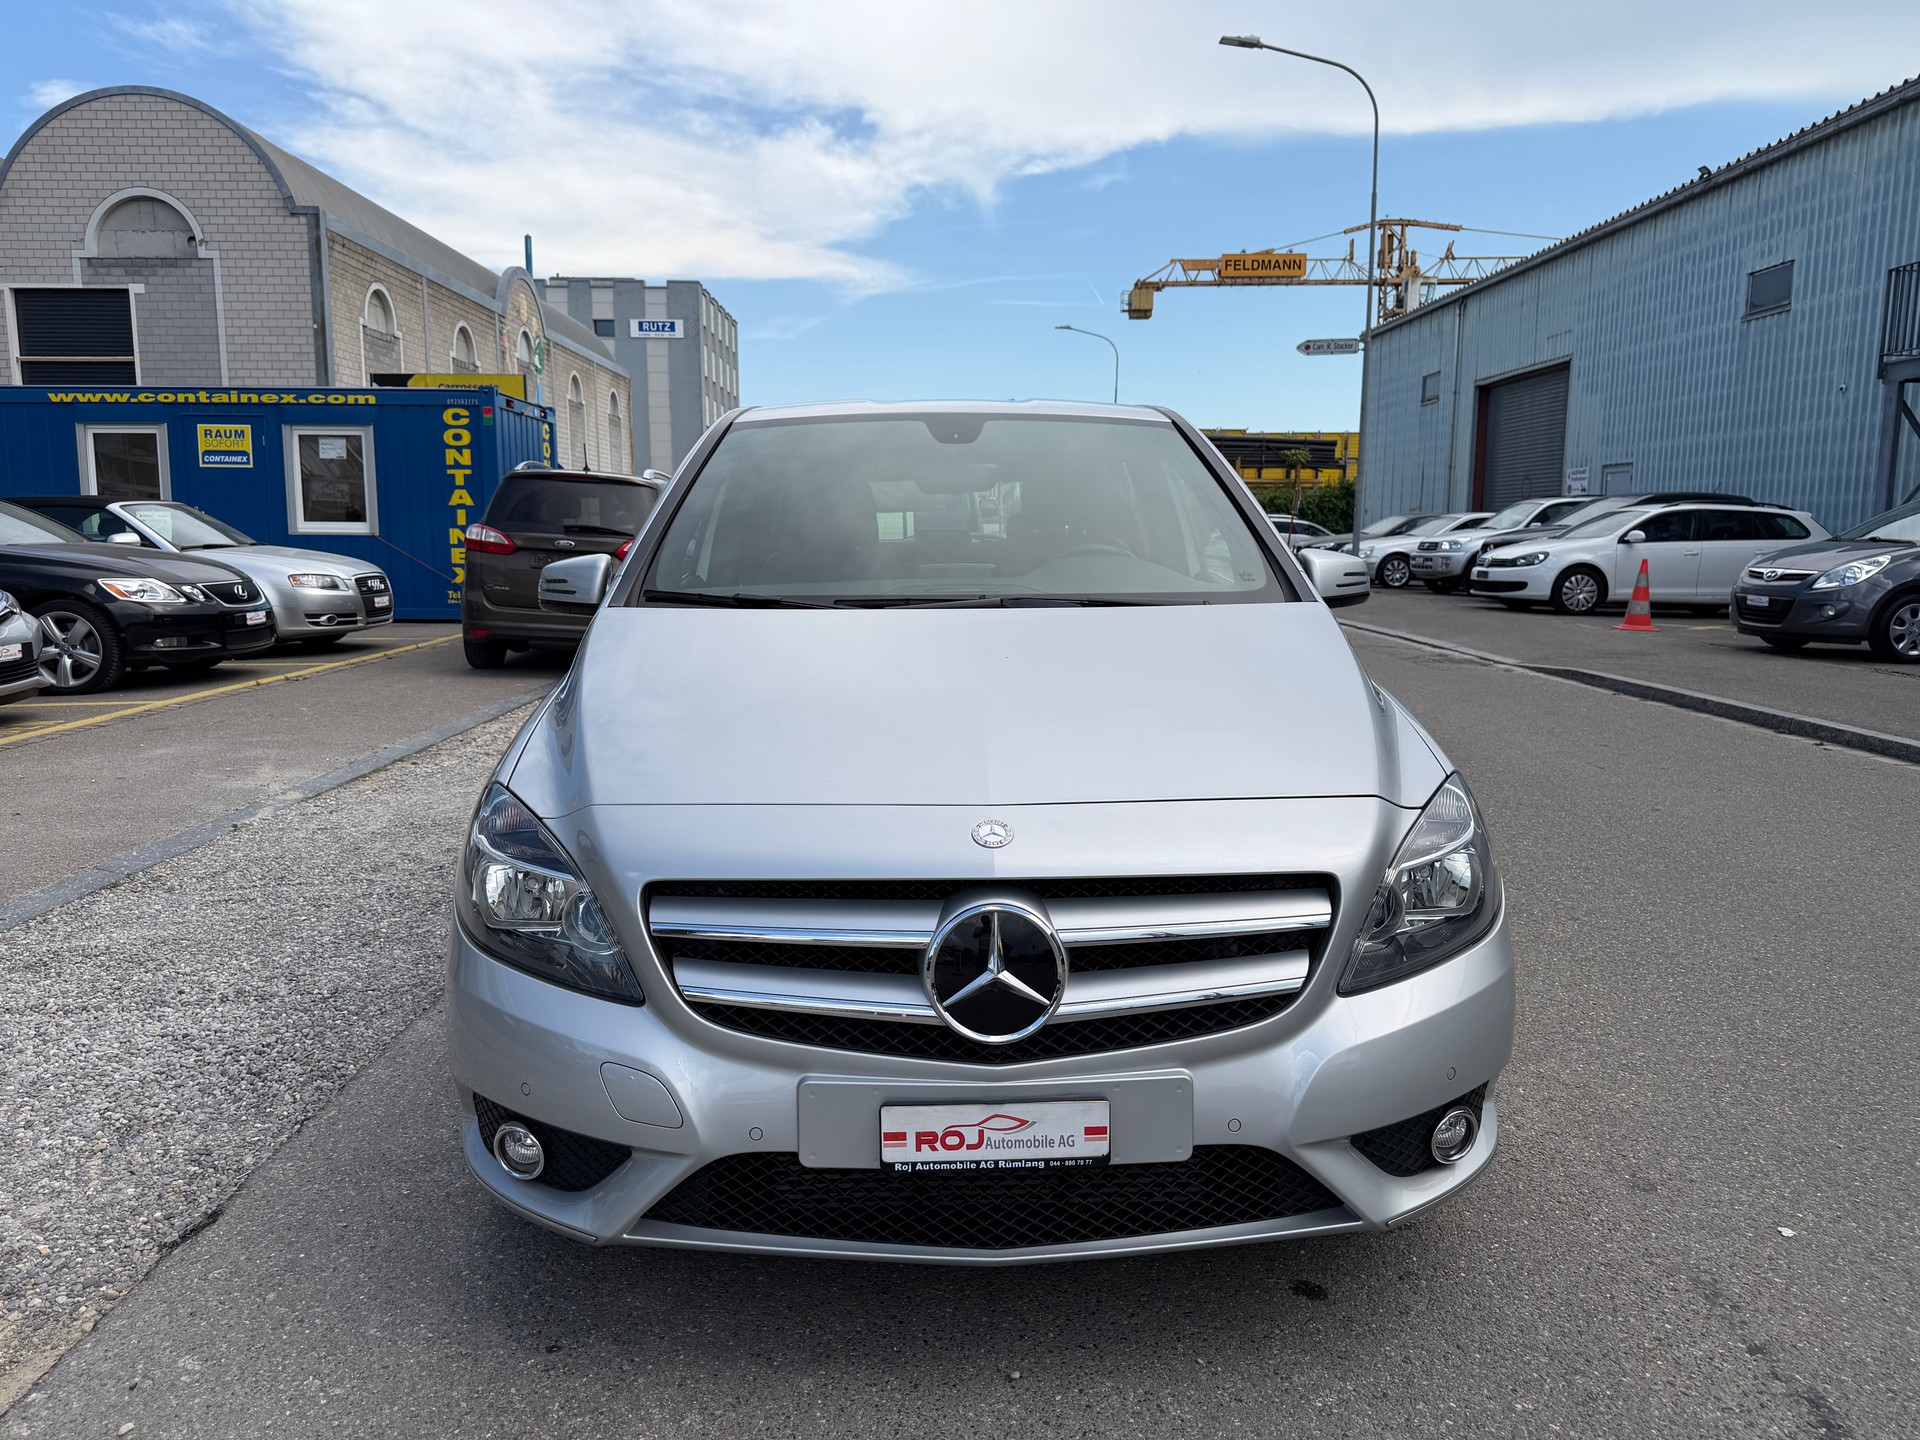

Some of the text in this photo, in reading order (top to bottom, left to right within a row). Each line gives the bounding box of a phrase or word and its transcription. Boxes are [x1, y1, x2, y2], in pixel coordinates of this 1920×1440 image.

[1224, 259, 1302, 271] FELDMANN
[642, 322, 671, 331] RUTZ
[47, 391, 376, 405] www.containex.com
[203, 428, 245, 439] RAUM
[204, 439, 245, 448] SOFORT
[203, 455, 248, 463] CONTAINEX
[915, 1129, 1075, 1152] ROJ Automobile AG
[894, 1162, 912, 1173] Roj
[915, 1161, 977, 1171] Automobile
[979, 1160, 995, 1169] AG
[998, 1159, 1045, 1169] Rümlang
